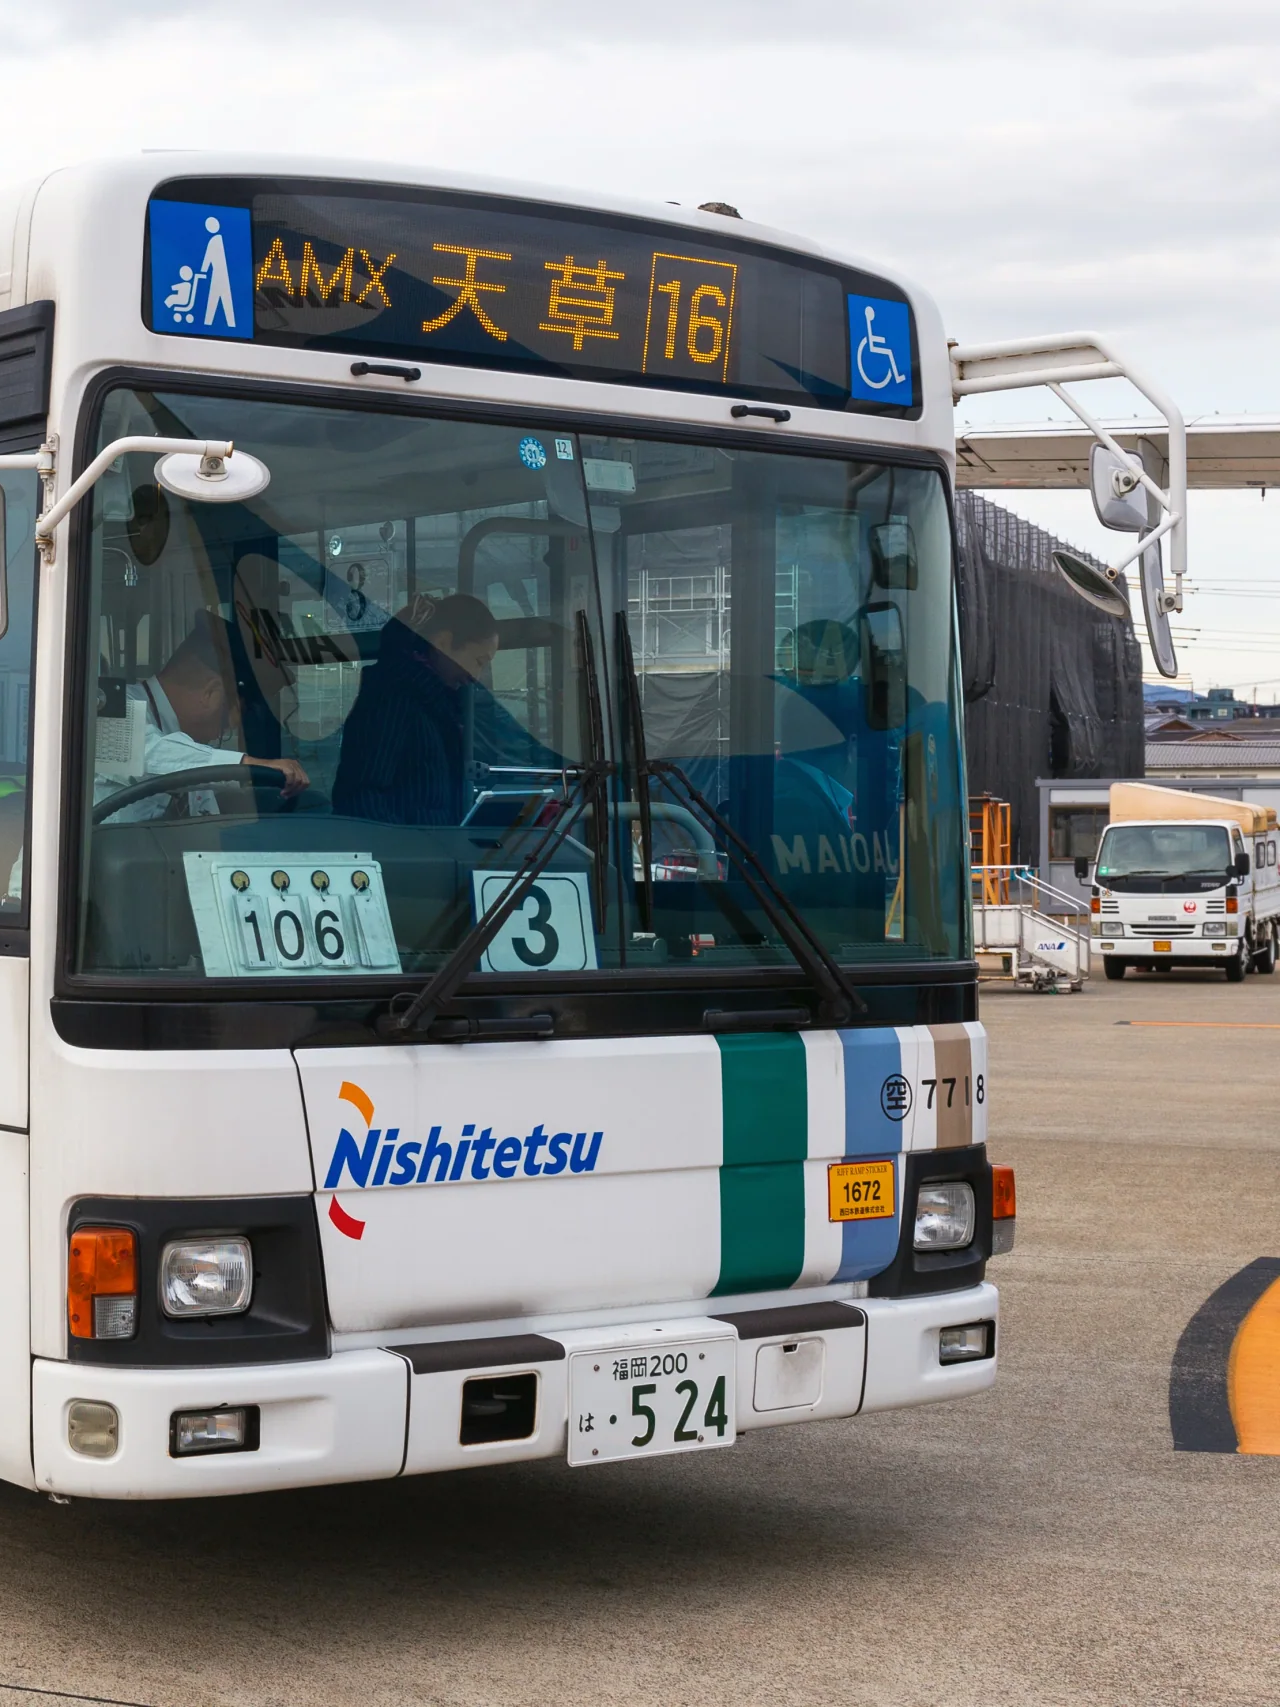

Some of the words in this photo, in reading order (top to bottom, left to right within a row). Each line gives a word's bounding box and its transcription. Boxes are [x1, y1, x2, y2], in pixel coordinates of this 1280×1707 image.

[255, 236, 397, 308] AMX
[421, 242, 626, 352] 天草
[656, 279, 725, 365] 16
[243, 909, 345, 963] 106
[511, 883, 560, 967] 3
[921, 1074, 985, 1109] 7718
[323, 1124, 604, 1189] Nishitetsu
[850, 1167, 865, 1175] RAMP
[866, 1165, 888, 1174] STICKER
[843, 1180, 881, 1203] 1672
